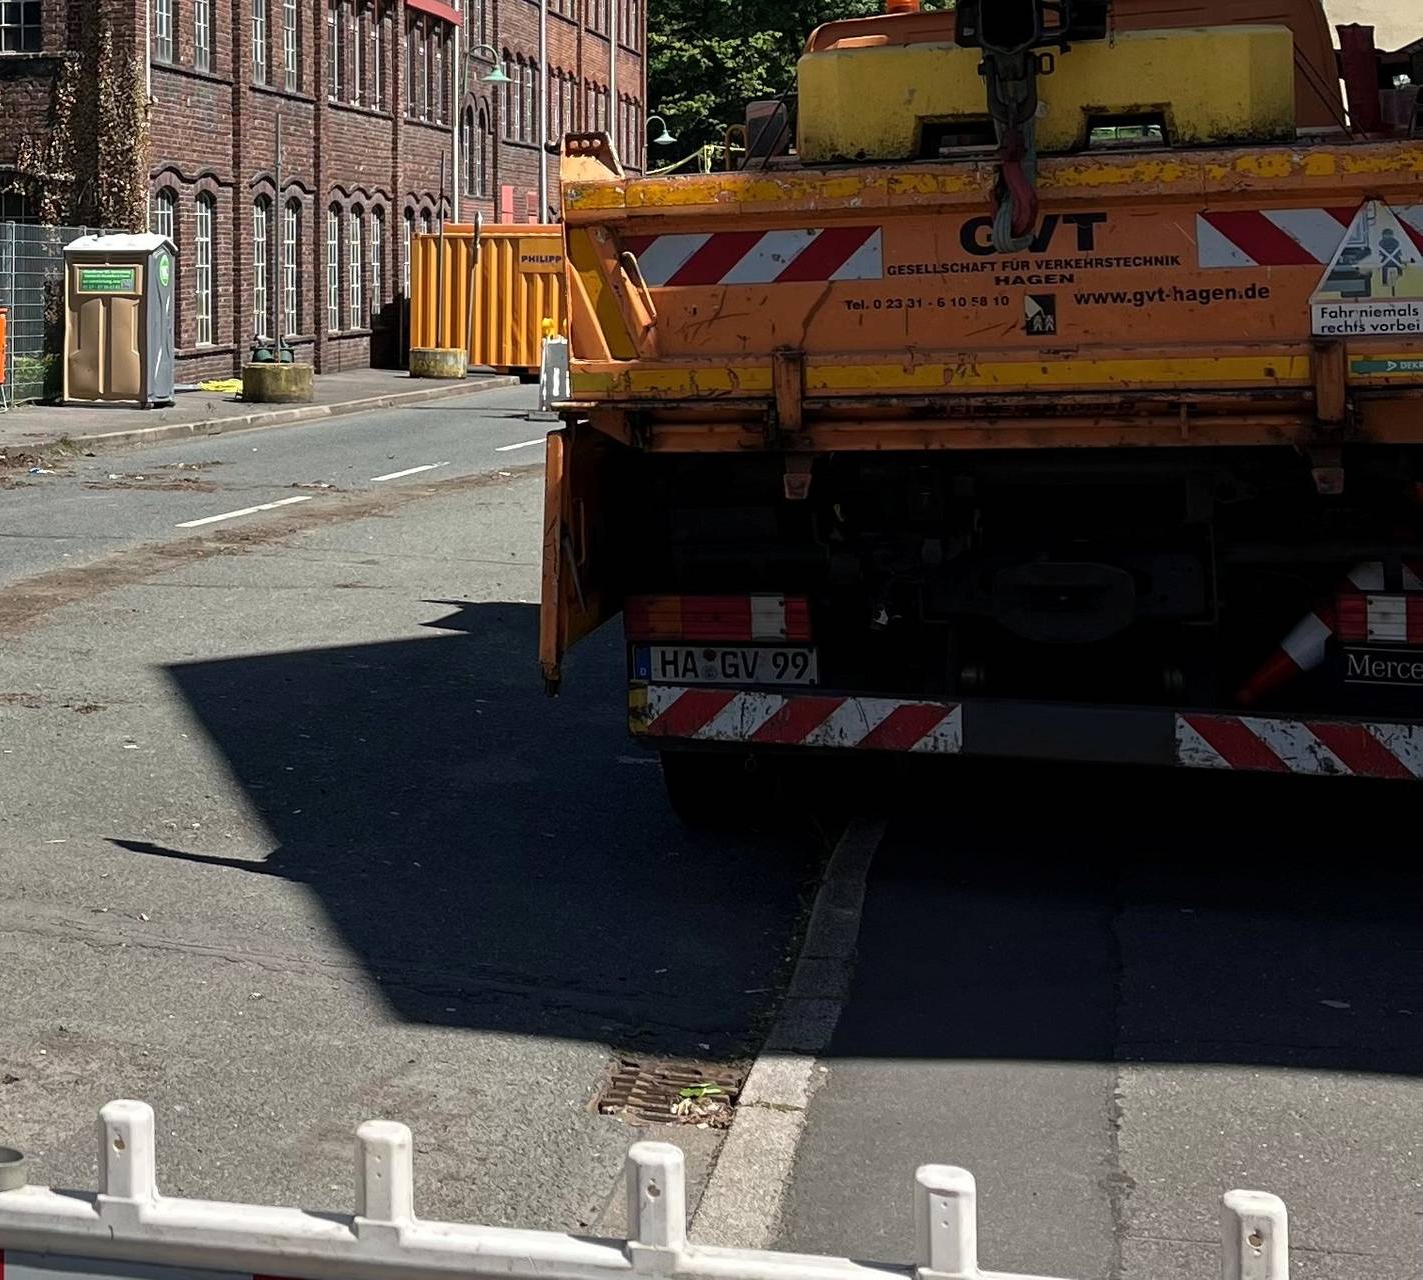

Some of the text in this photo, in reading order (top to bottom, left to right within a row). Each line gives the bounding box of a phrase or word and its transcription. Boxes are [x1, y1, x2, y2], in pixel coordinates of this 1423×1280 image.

[960, 212, 1107, 256] GVT
[521, 255, 562, 263] PHILIPP
[887, 255, 1181, 276] GESELLSCHAFT FÜR VERKEHRSTECHNIK
[994, 274, 1074, 286] HAGEN
[1073, 283, 1271, 307] www.gvt-hagen.de
[845, 299, 869, 310] Tel.
[873, 299, 882, 309] 0
[886, 299, 903, 309] 23
[907, 298, 922, 308] 31
[936, 297, 946, 308] 6
[950, 297, 967, 307] 10
[993, 296, 1010, 306] 10
[1320, 304, 1418, 319] Fahr niemals
[1321, 319, 1420, 333] rechts vorbei
[639, 666, 648, 676] D
[661, 650, 809, 680] HA GV 99
[1347, 654, 1423, 679] Merce
